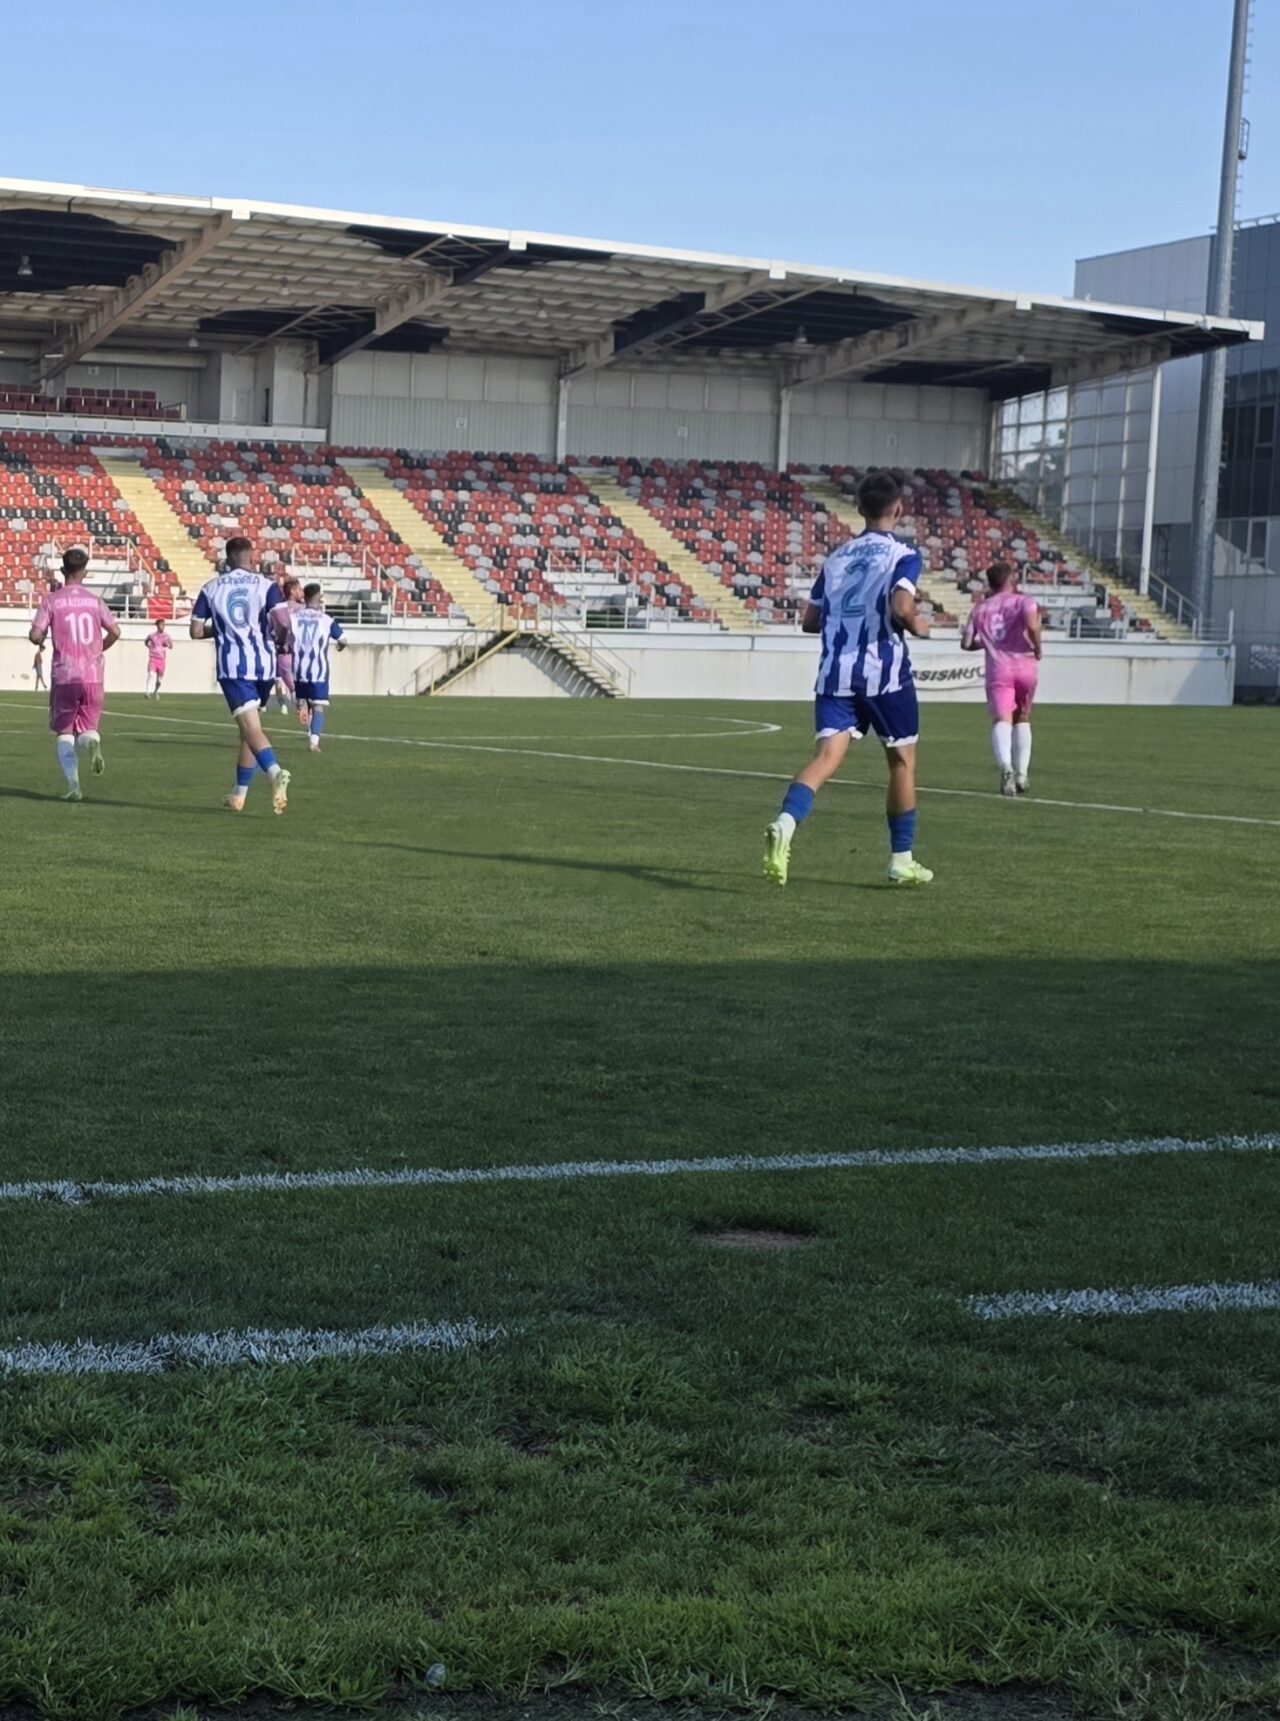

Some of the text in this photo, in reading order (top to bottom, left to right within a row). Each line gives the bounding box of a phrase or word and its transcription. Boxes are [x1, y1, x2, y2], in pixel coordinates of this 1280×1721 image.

[841, 558, 870, 618] 2
[226, 587, 251, 629] 6
[65, 611, 94, 646] 10
[298, 619, 319, 645] 77
